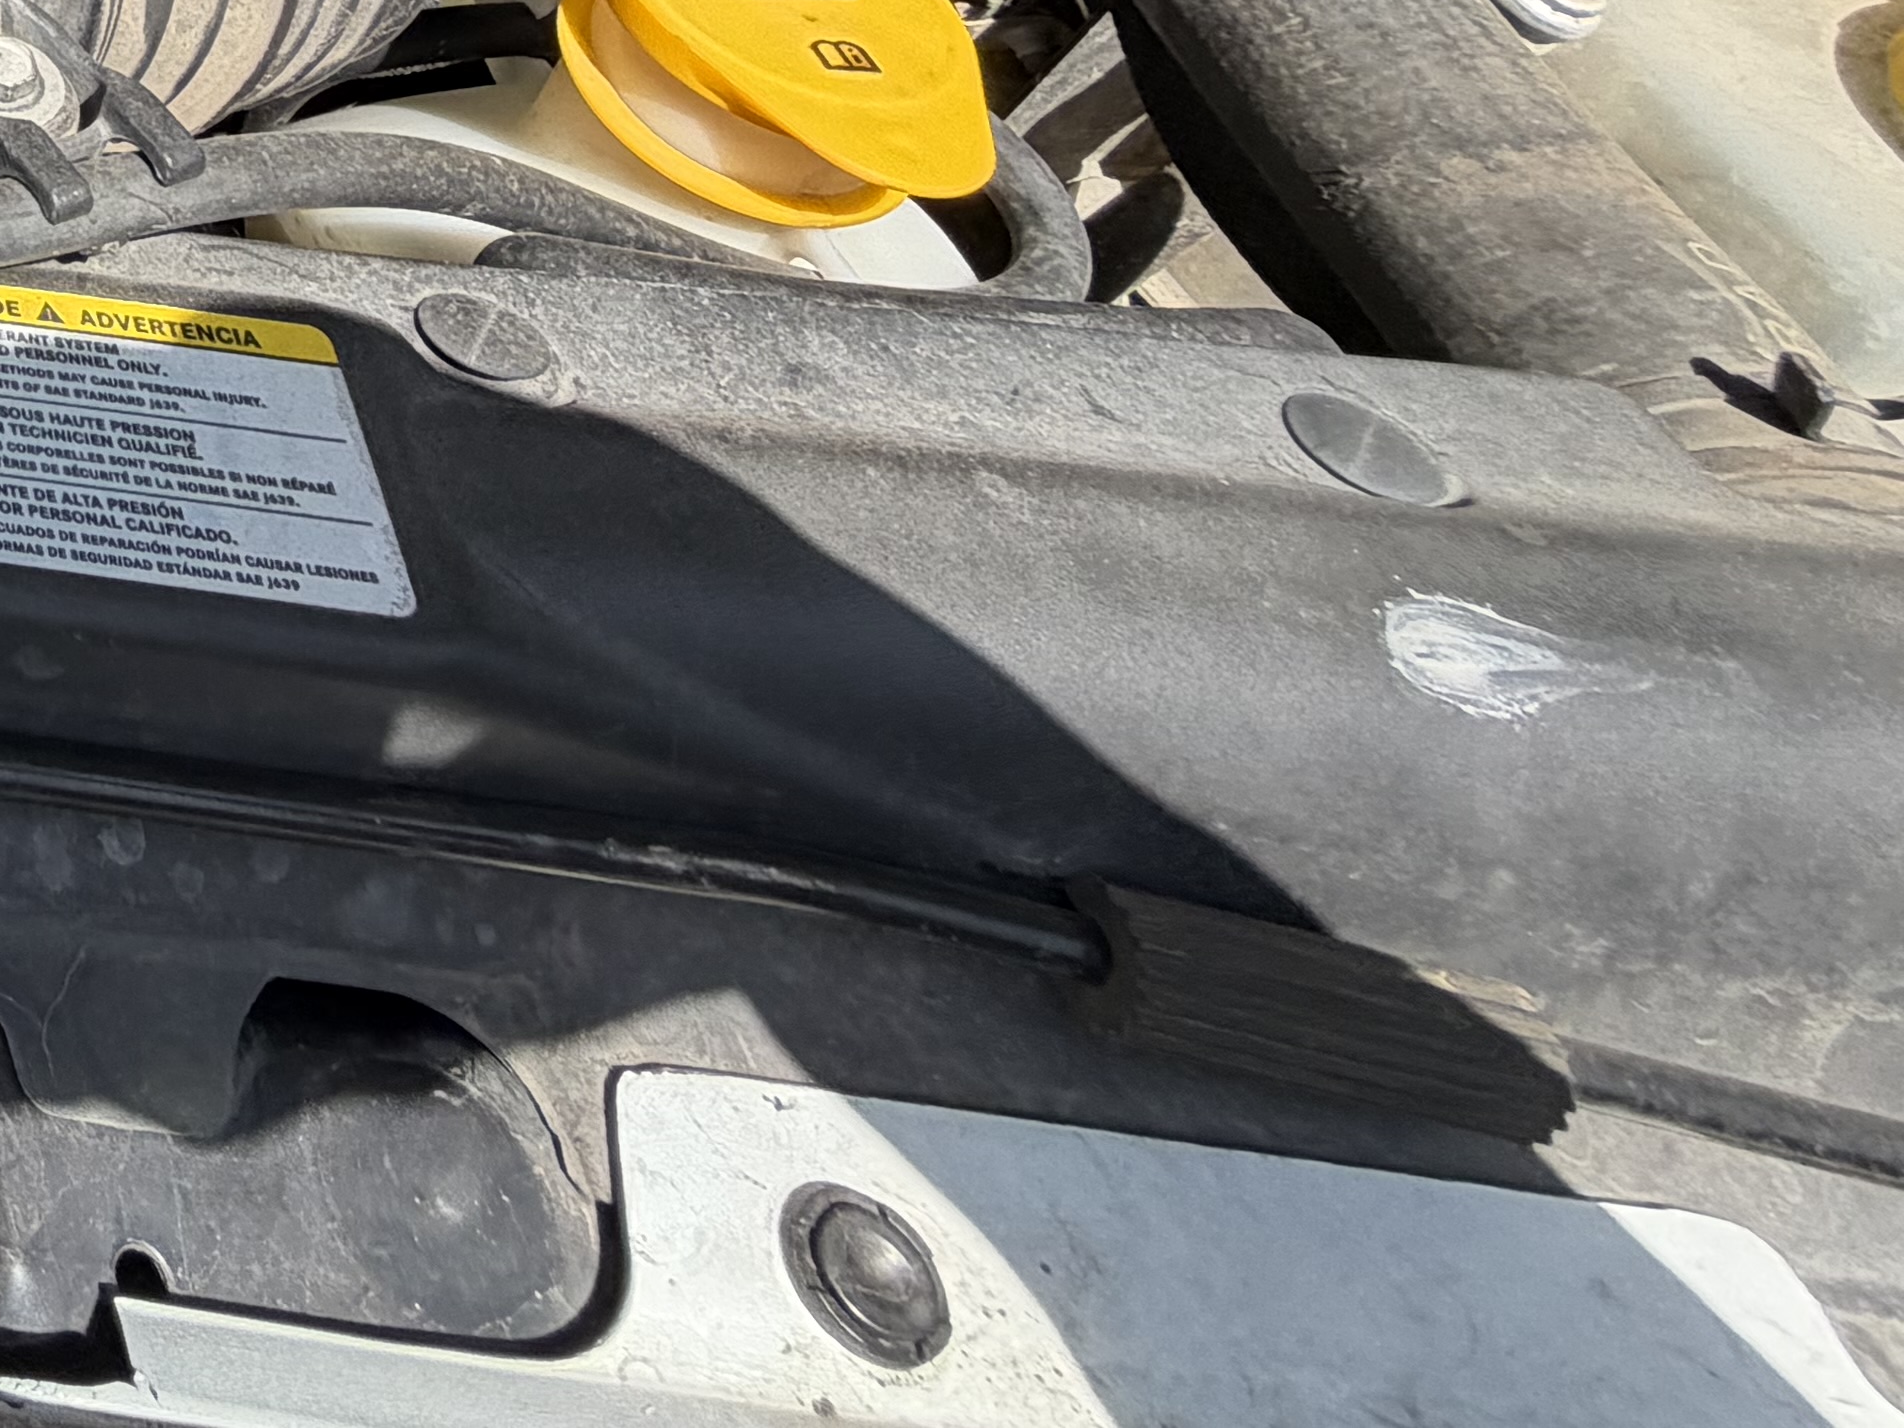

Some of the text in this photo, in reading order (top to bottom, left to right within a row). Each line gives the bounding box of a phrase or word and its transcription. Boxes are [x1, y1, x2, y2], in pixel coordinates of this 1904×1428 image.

[54, 336, 119, 356] SYSTEM
[80, 309, 262, 349] ADVERTENCIA
[15, 346, 114, 370] PERSONNEL
[118, 360, 168, 377] ONLY.
[23, 381, 40, 393] OF
[44, 384, 70, 398] SAE
[73, 387, 145, 407] STANDARD
[58, 371, 87, 384] MAY
[90, 375, 135, 390] CAUSE
[138, 382, 209, 399] PERSONAL
[212, 391, 267, 409] INJURY.
[8, 422, 113, 448] TECHNICIEN
[117, 438, 203, 461] QUALIFIÉ.
[49, 411, 105, 432] HAUTE
[110, 420, 195, 443] PRESSION
[5, 441, 106, 465] CORPORELLES
[108, 456, 146, 470] SONT
[149, 461, 225, 481] POSSIBLES
[229, 471, 243, 483] SI
[246, 473, 278, 488] NON
[280, 475, 337, 496] RÉPARÉ
[41, 462, 59, 474] DE
[63, 463, 130, 484] SÉCURITÉ
[134, 475, 152, 487] DE
[155, 478, 174, 490] LA
[178, 481, 229, 497] NORME
[233, 489, 260, 502] SAE
[33, 488, 58, 503] DE
[62, 491, 103, 510] ALTA
[107, 496, 184, 520] PRESIÓN
[28, 505, 122, 530] PERSONAL
[125, 519, 238, 545] CALIFICADO.
[47, 545, 67, 560] DE
[70, 548, 153, 571] SEGURIDAD
[157, 559, 233, 581] ESTÁNDAR
[236, 571, 264, 586] SAE
[59, 530, 77, 543] DE
[81, 532, 172, 556] REPARACIÓN
[176, 545, 241, 566] PODRÍAN
[244, 555, 304, 574] CAUSAR
[306, 563, 380, 584] LESIONES
